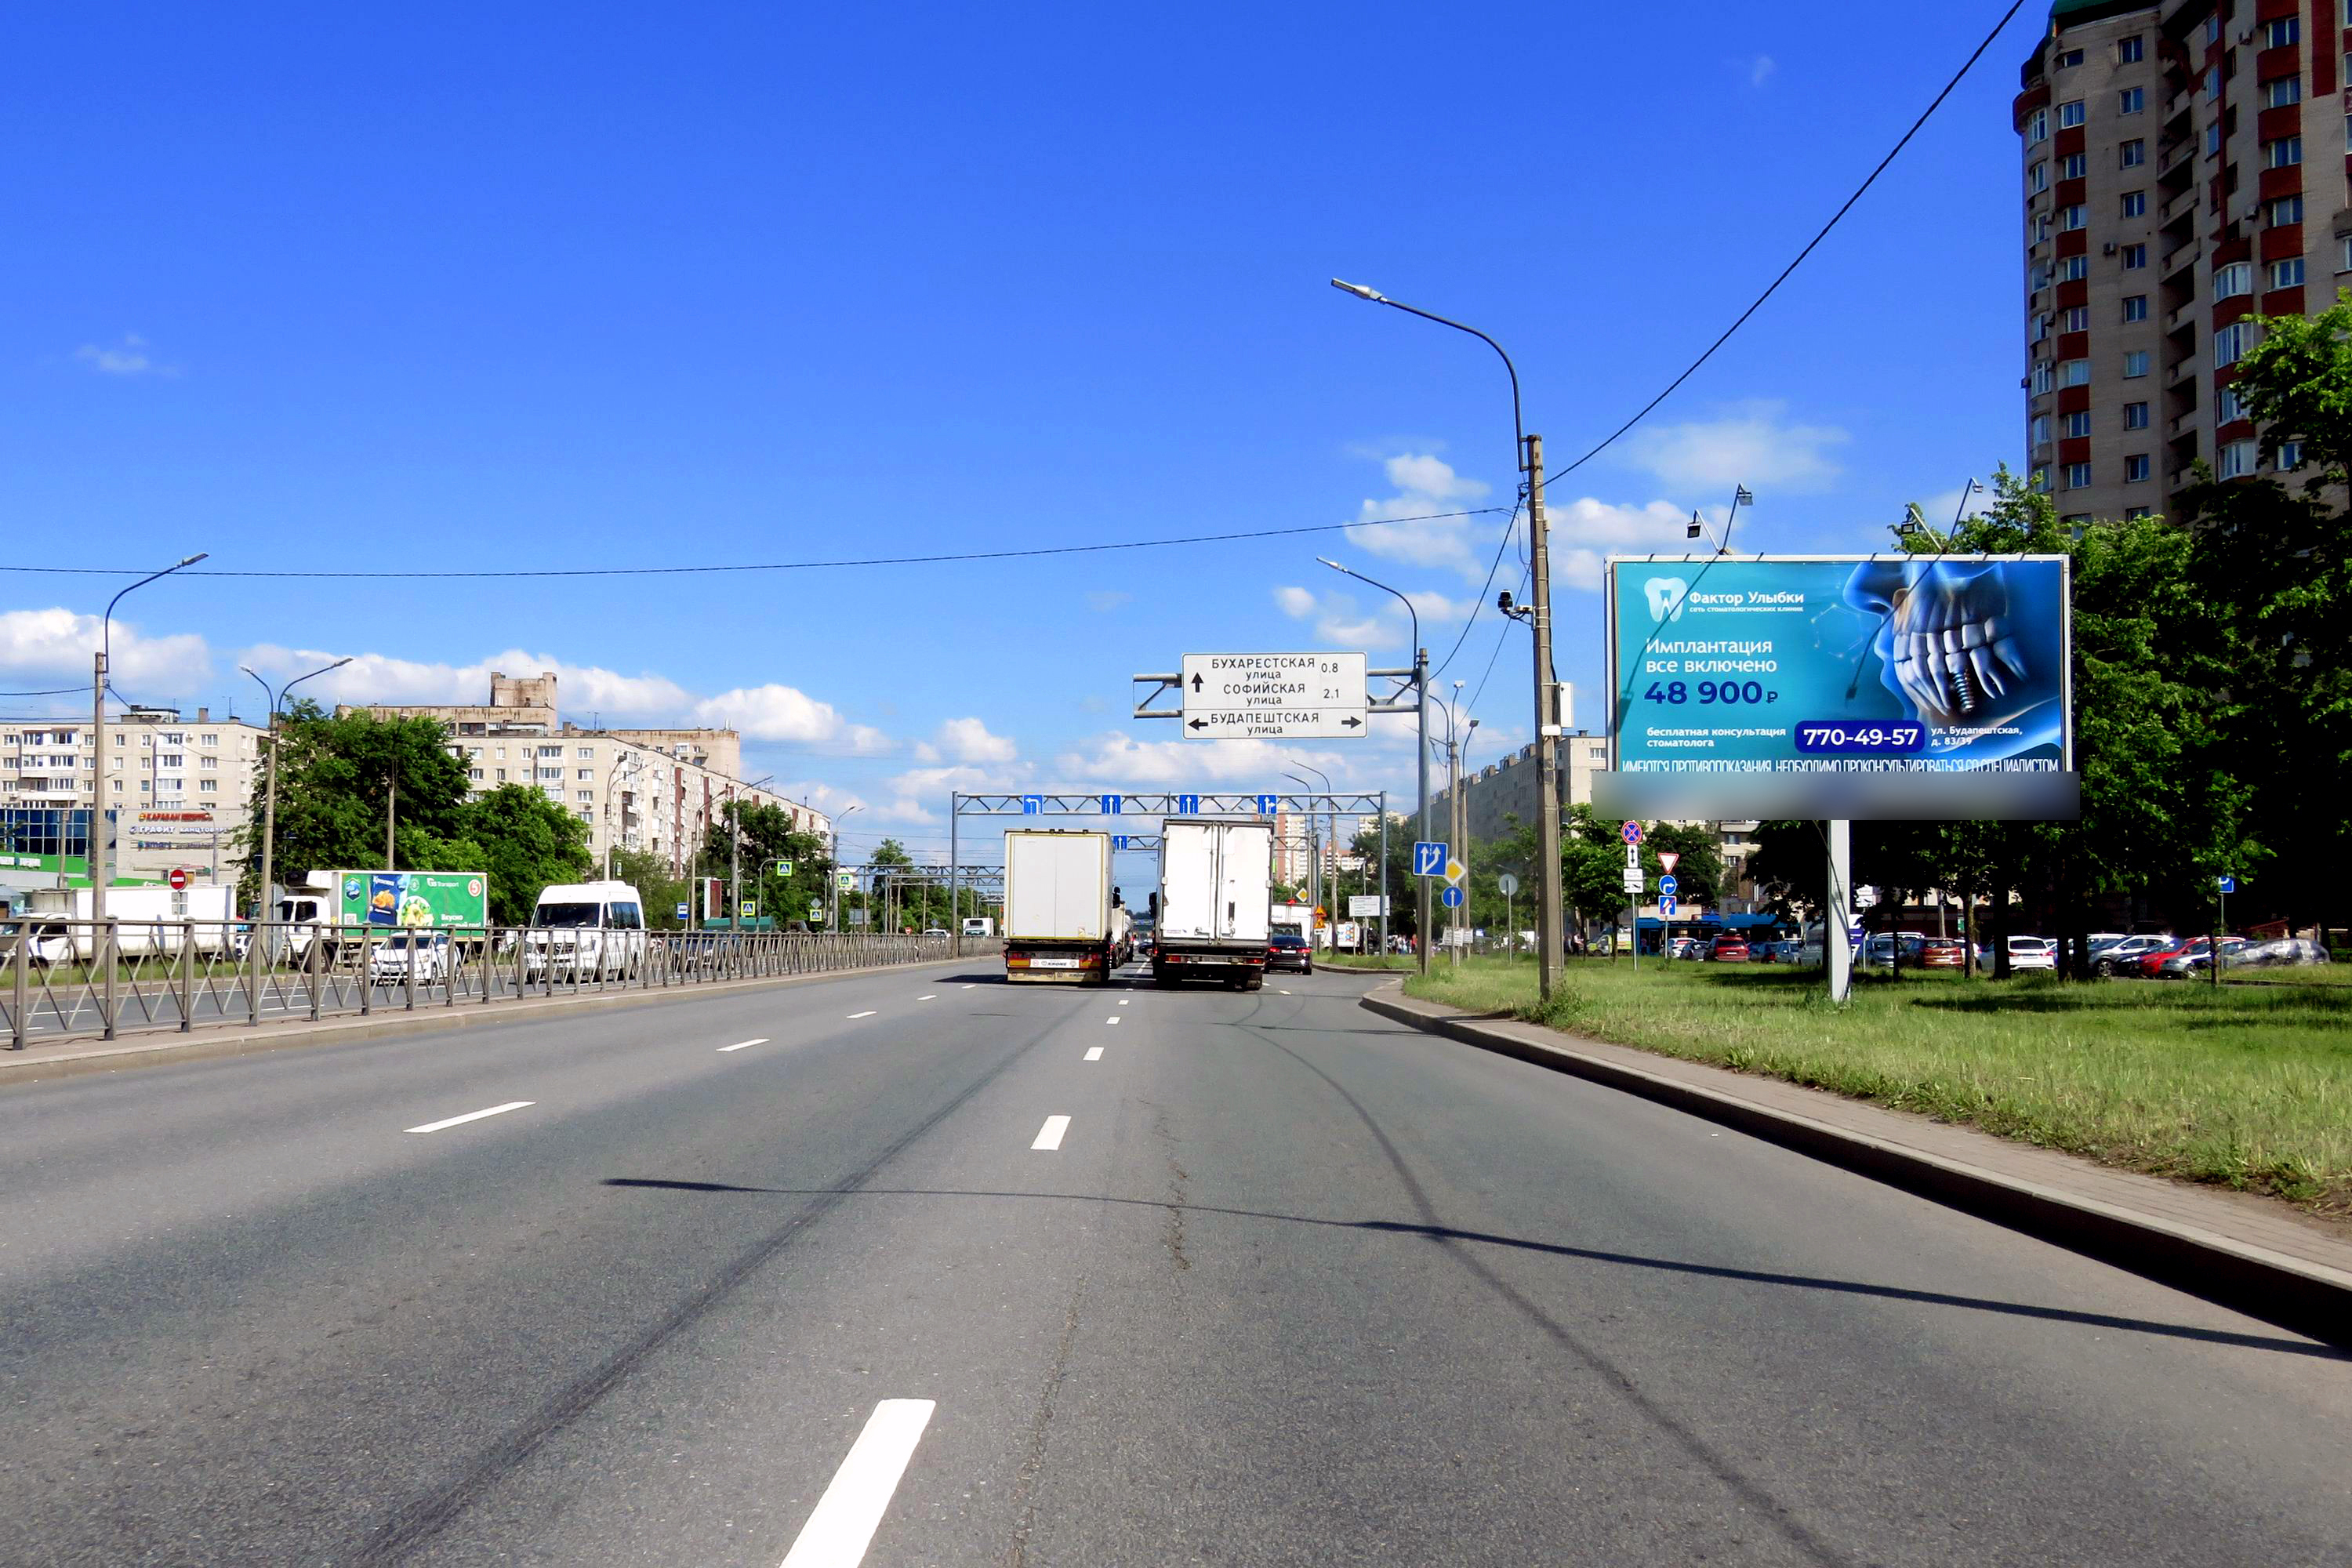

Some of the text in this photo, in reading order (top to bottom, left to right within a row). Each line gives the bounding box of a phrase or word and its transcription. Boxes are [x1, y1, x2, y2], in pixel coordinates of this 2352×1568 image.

[1689, 591, 1804, 606] Фактор Улыбки
[1646, 637, 1773, 656] Имплантация
[1212, 658, 1316, 669] БУХАРЕСТСКАЯ
[1646, 660, 1777, 673] все включено
[1246, 670, 1282, 681] улица
[1223, 681, 1305, 695] СОФИЙСКАЯ
[1644, 681, 1687, 705] 48
[1697, 681, 1762, 705] 900
[1246, 696, 1282, 706] улица
[1210, 713, 1319, 724] БУДАПЕШТСКАЯ
[1247, 726, 1283, 736] улица
[1646, 727, 1786, 738] бесплатная консультация
[1949, 726, 2024, 735] Будапештская,
[1802, 728, 1919, 746] 770-49-57
[1944, 736, 1973, 746] 83/39
[1646, 739, 1715, 749] стоматолога
[1622, 760, 1670, 772] ИМЕЮТСЯ
[138, 826, 176, 834] ГРАФИТ
